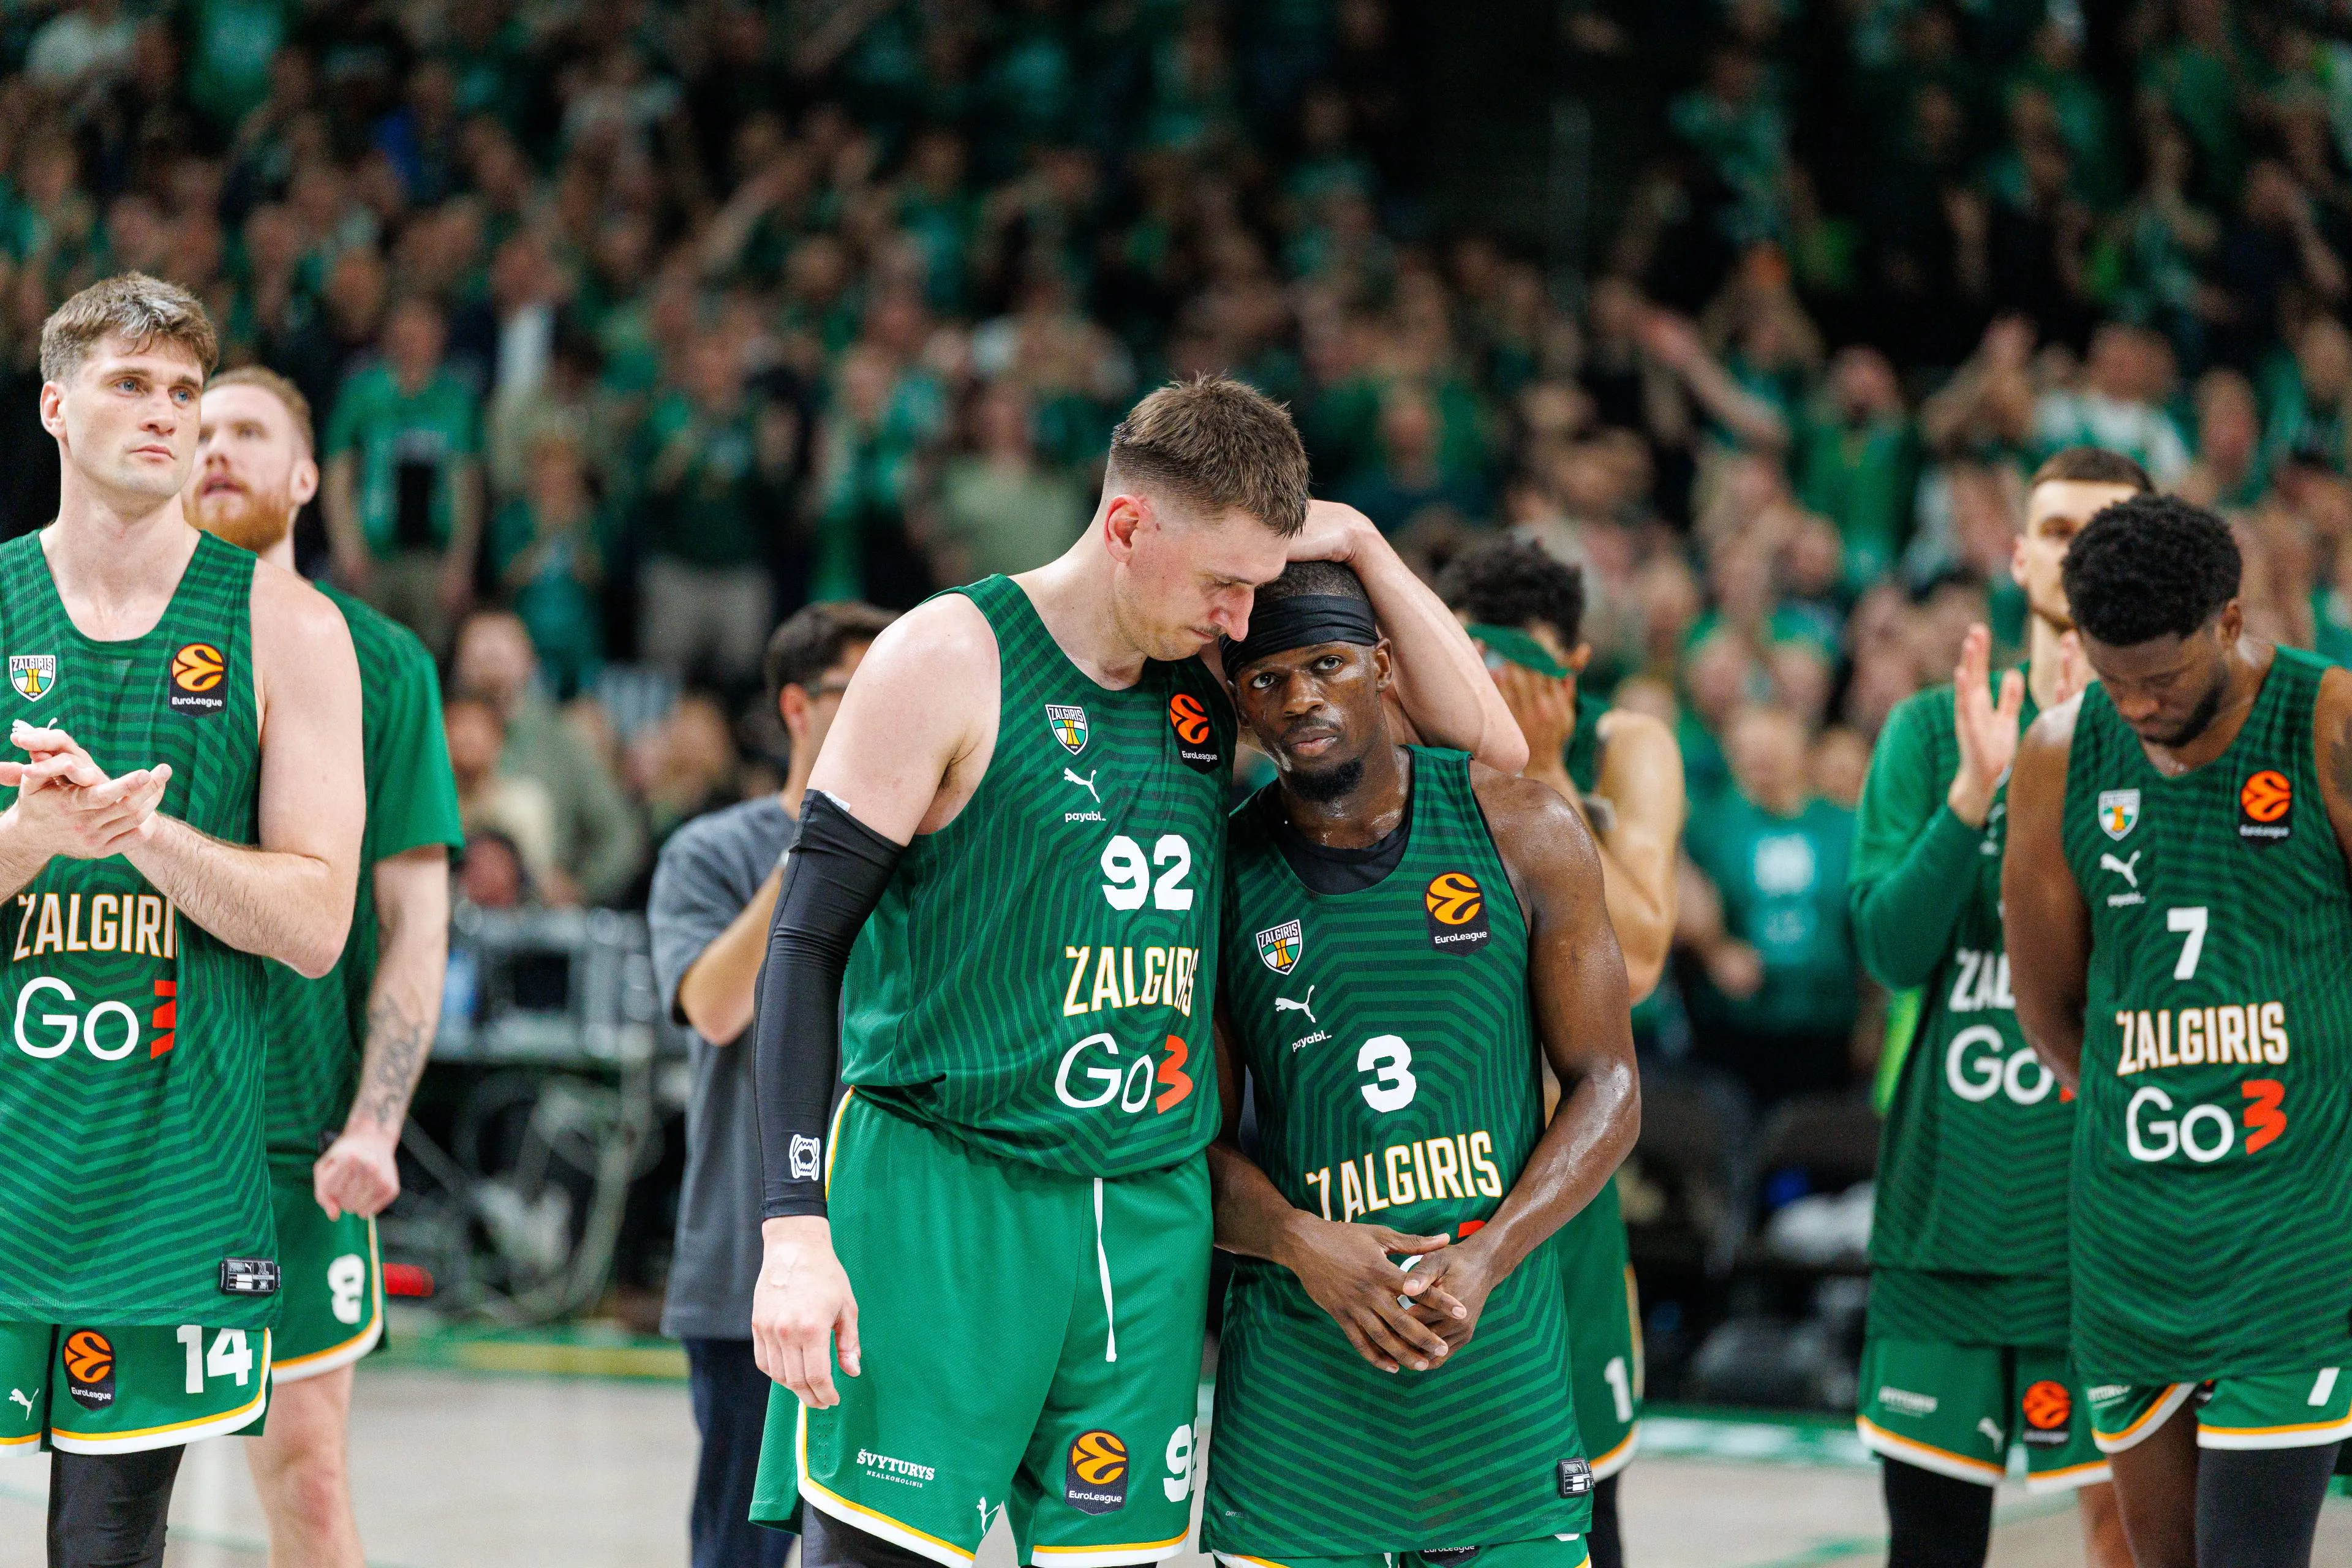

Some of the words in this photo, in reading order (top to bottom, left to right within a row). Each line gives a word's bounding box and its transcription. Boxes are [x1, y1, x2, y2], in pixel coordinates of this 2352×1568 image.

[172, 696, 222, 707] EuroLeague
[1049, 707, 1084, 722] ZALGIRIS
[1182, 750, 1218, 761] EuroLeague
[1101, 834, 1194, 911] 92
[13, 892, 178, 962] ZALGIRI
[1259, 923, 1298, 949] ZALGIRIS
[1434, 931, 1487, 944] EuroLeague
[2167, 907, 2208, 980] 7
[1063, 946, 1199, 1017] ZALGIRS
[1946, 1025, 2075, 1104] Go
[2115, 1001, 2290, 1076] ZALGIRIS
[1055, 1033, 1193, 1114] Go3
[1357, 1034, 1417, 1113] 3
[2126, 1079, 2288, 1163] Go3
[1305, 1131, 1502, 1223] ZALGIRIS
[71, 1386, 111, 1401] EuroLeague
[176, 1325, 252, 1393] 14
[856, 1449, 935, 1480] ŠVYTURYS
[866, 1470, 923, 1488] NEALKOHOLINIS
[1069, 1490, 1122, 1504] EuroLeague
